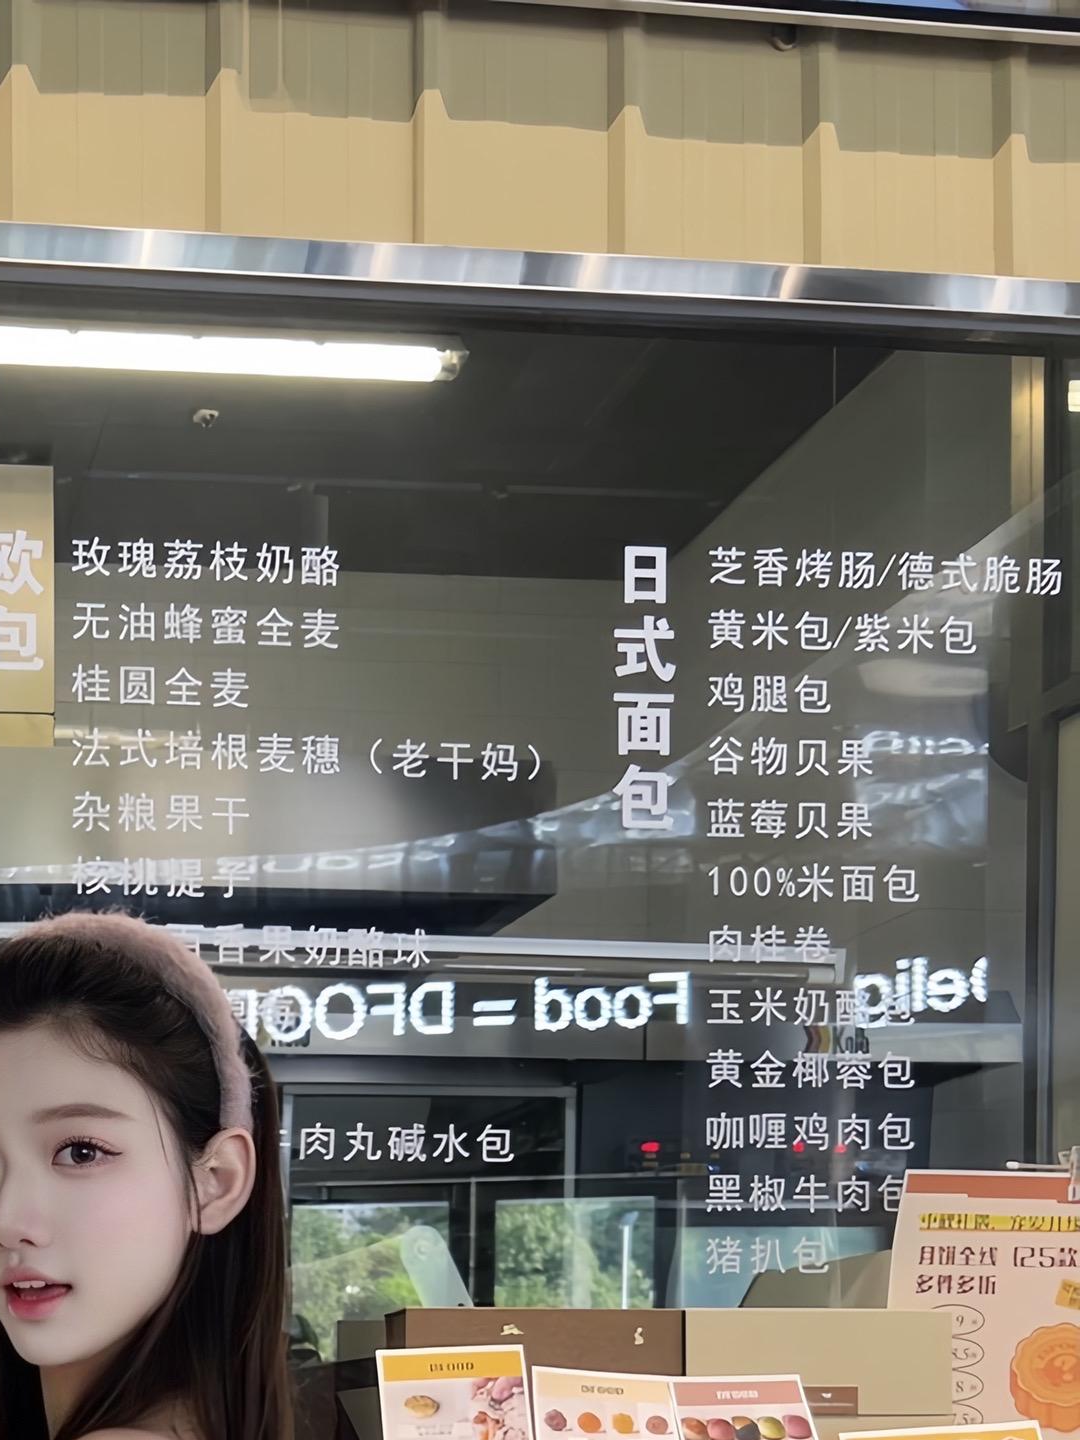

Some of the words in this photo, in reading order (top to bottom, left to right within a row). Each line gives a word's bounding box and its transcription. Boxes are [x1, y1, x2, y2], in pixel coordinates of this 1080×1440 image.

[71, 536, 341, 587] 玫瑰荔枝奶酪
[708, 546, 1063, 596] 芝香烤肠/德式脆肠
[71, 602, 341, 649] 无油蜂蜜全麦
[708, 609, 978, 655] 黄米包/紫米包
[71, 662, 250, 709] 桂圆全麦
[613, 545, 677, 832] 日式面包
[707, 673, 832, 714] 鸡腿包
[707, 736, 874, 778] 谷物贝果
[71, 791, 251, 836] 杂粮果干
[707, 798, 873, 840] 蓝莓贝果
[71, 856, 251, 898] 核桃提子
[708, 863, 920, 903] 100%米面包
[707, 924, 832, 964] 肉桂卷
[706, 1049, 916, 1090] 黄金椰蓉包
[280, 1121, 515, 1163] 肉丸碱水包
[705, 1111, 916, 1151] 咖喱鸡肉包
[705, 1174, 905, 1214] 黑椒牛肉包
[705, 1235, 830, 1275] 猪扒包
